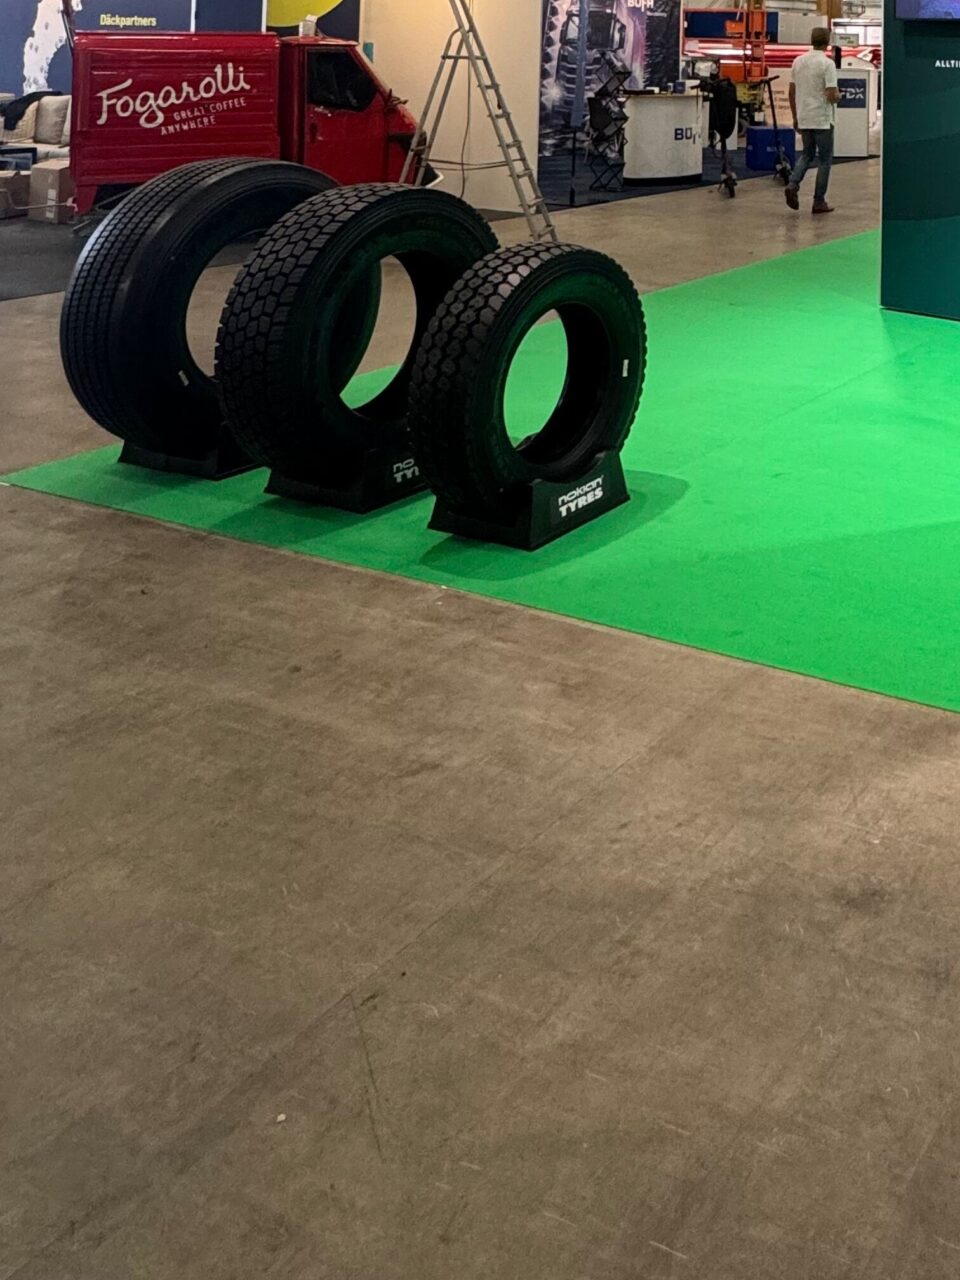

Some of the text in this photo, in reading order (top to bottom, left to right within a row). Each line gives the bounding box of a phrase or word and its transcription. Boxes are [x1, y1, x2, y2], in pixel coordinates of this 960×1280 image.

[100, 14, 157, 28] Däckpartners
[96, 62, 251, 128] Fogarolli
[174, 96, 247, 121] GREAT COFFEE
[161, 115, 217, 135] ANYWHERE
[558, 477, 602, 506] nokian
[559, 487, 604, 517] TYRES
